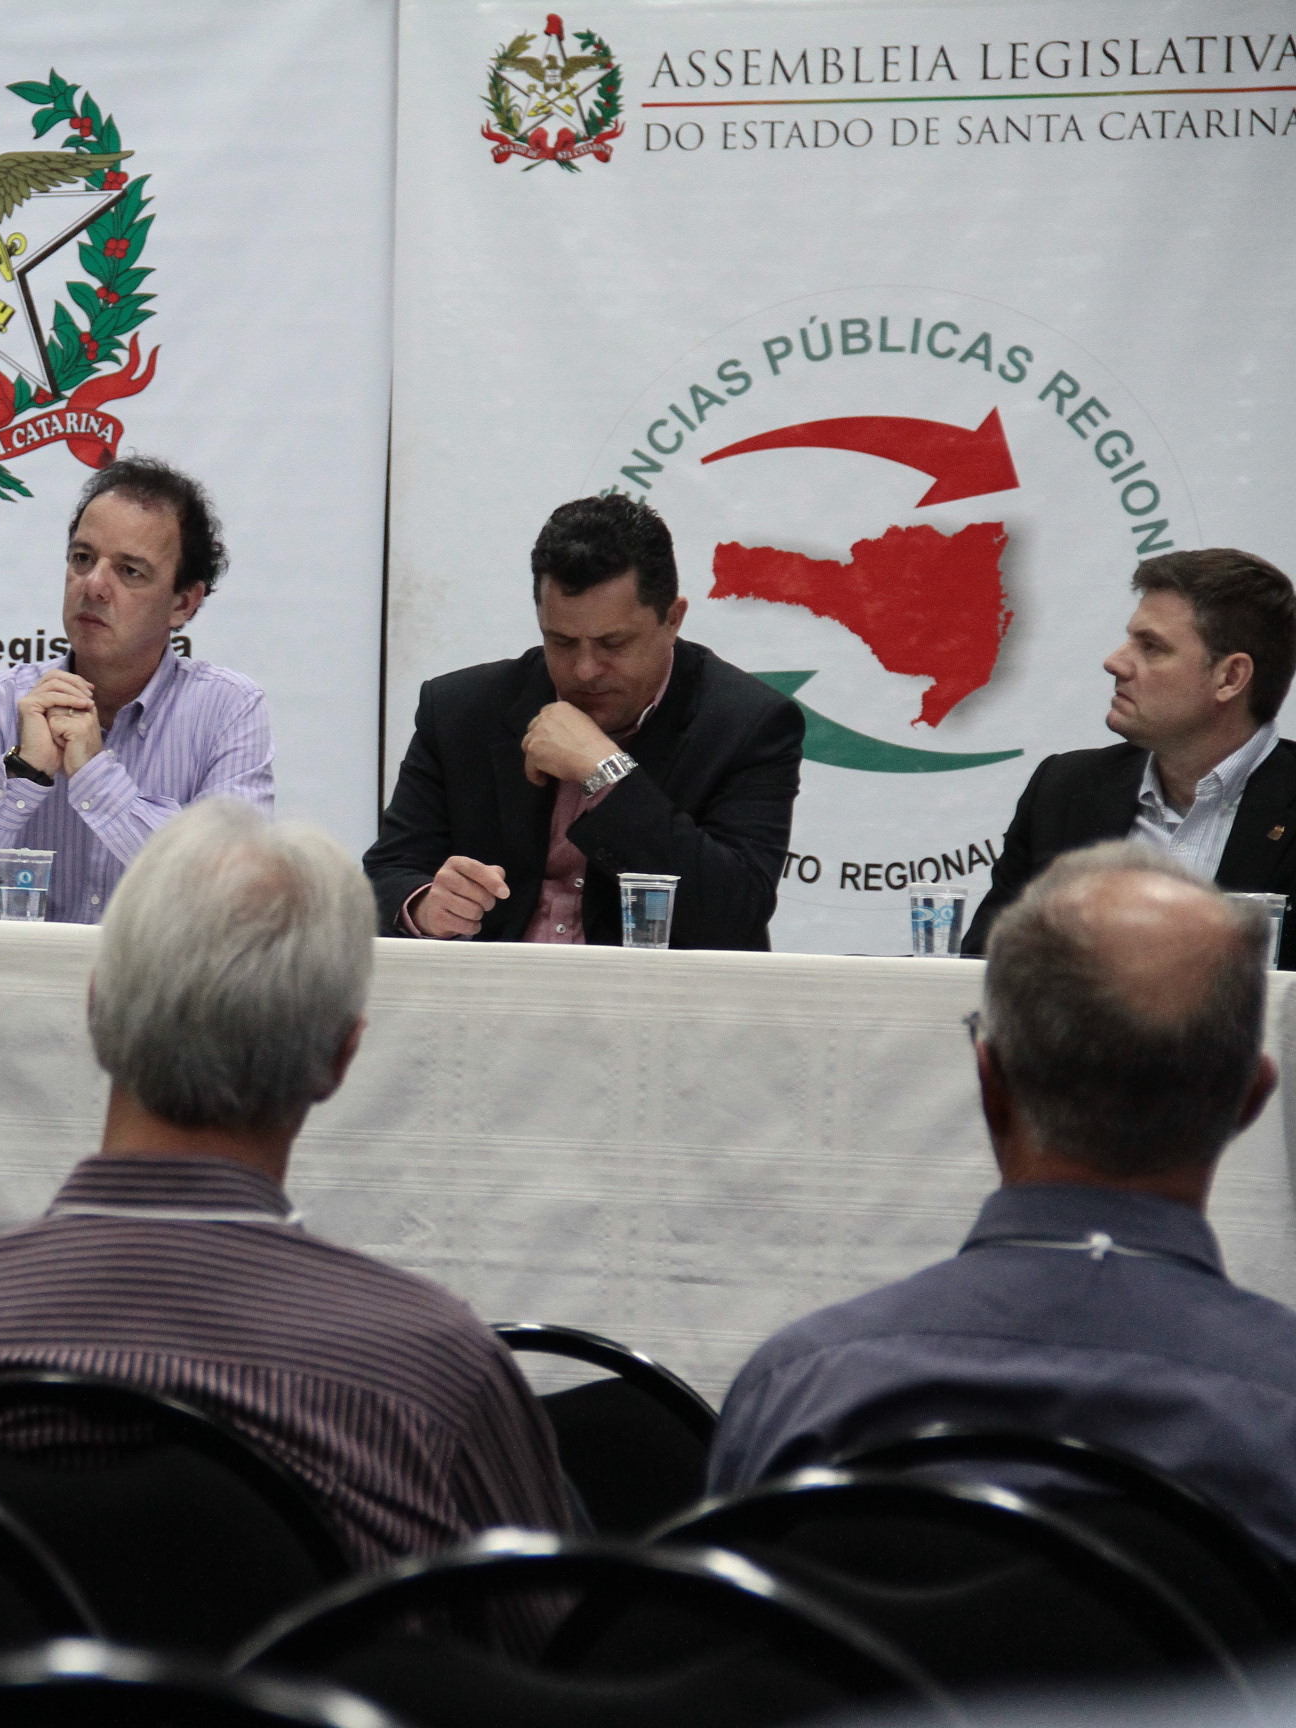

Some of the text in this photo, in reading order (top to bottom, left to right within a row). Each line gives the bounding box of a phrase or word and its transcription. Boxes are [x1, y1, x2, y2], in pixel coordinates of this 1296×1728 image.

[649, 33, 1296, 88] ASSEMBLEIA LEGISLATIVA
[644, 121, 705, 151] DO
[721, 117, 874, 150] ESTADO
[890, 116, 940, 147] DE
[956, 112, 1086, 145] SANTA
[12, 411, 114, 449] CATARINA
[600, 358, 752, 503] NCIAS
[762, 314, 1034, 384] PÚBLICAS
